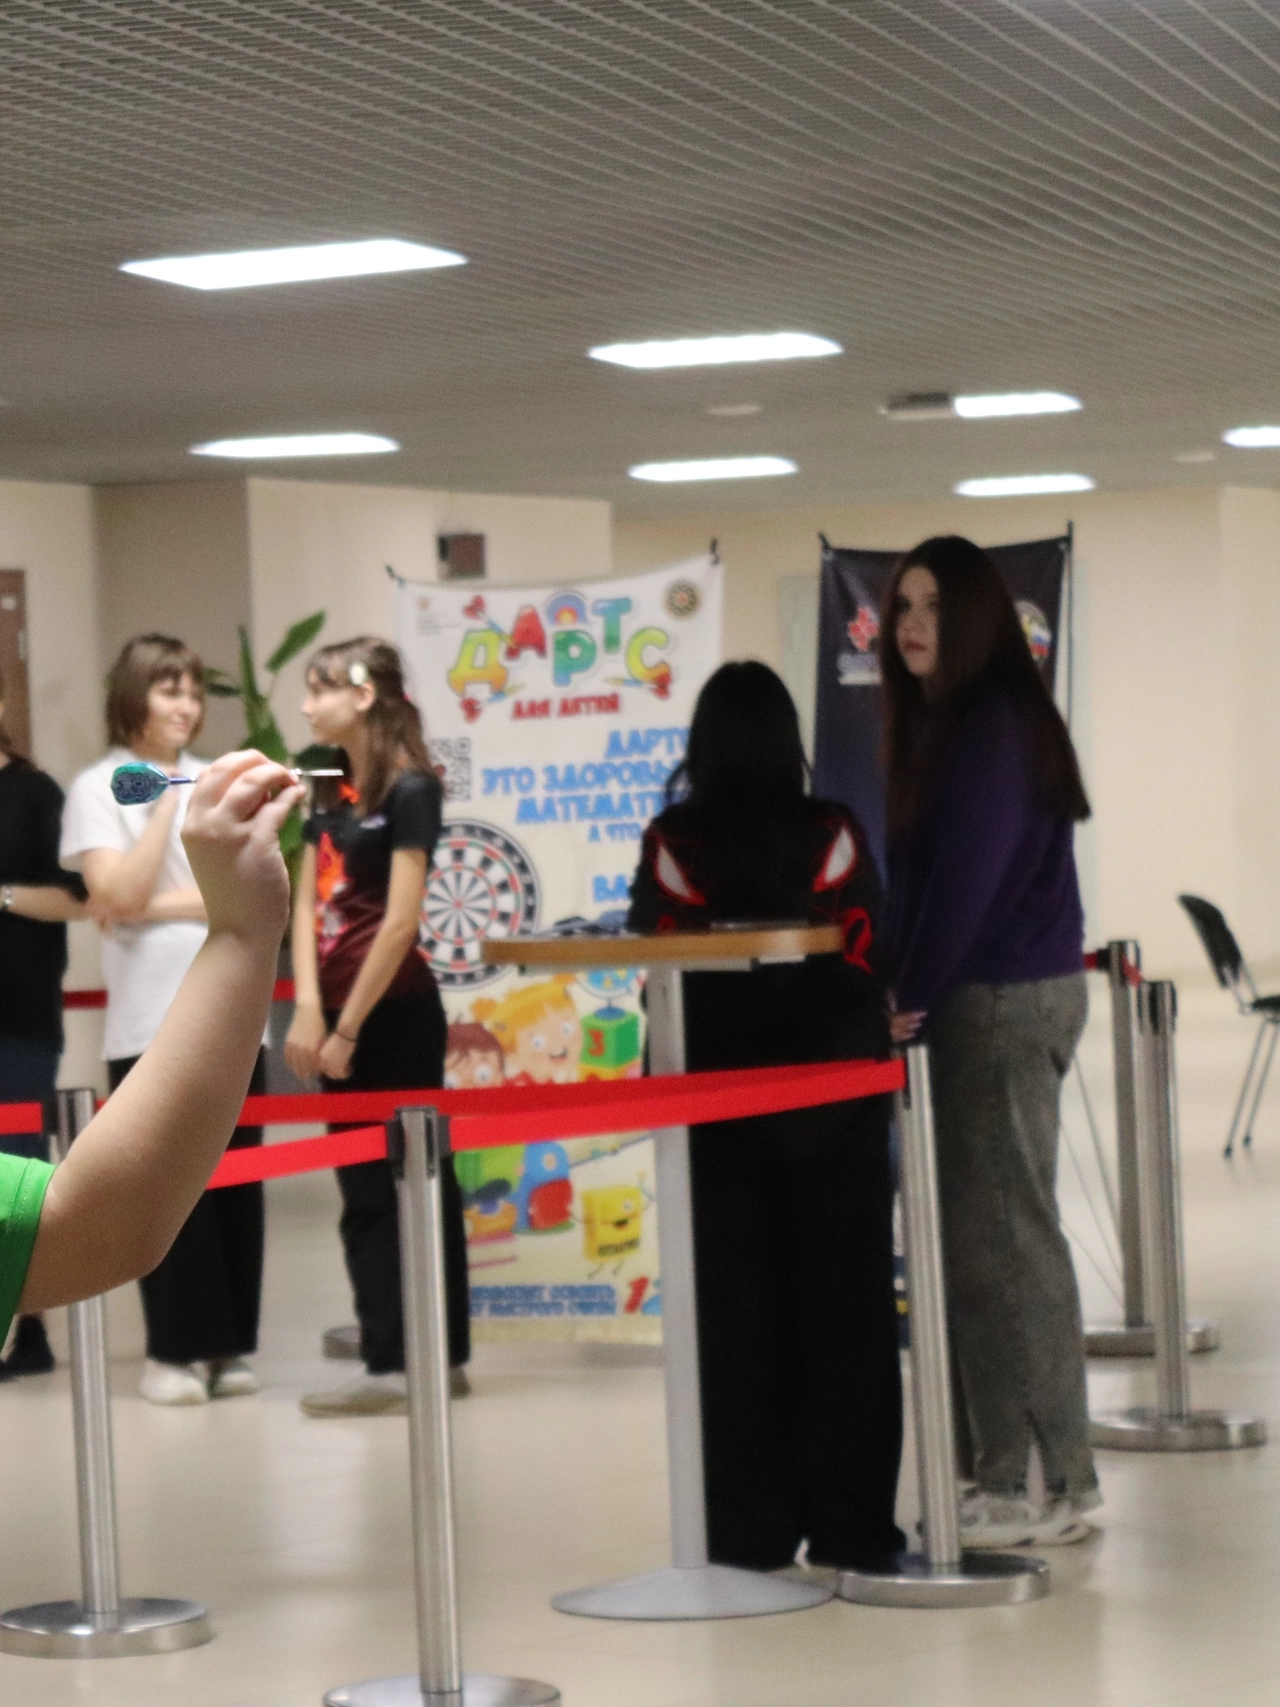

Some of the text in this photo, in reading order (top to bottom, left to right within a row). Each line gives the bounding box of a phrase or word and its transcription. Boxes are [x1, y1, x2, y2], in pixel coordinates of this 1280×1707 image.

[447, 597, 672, 697] ДАРТС
[481, 759, 681, 795] ЭТО ЗДОРОВЬ
